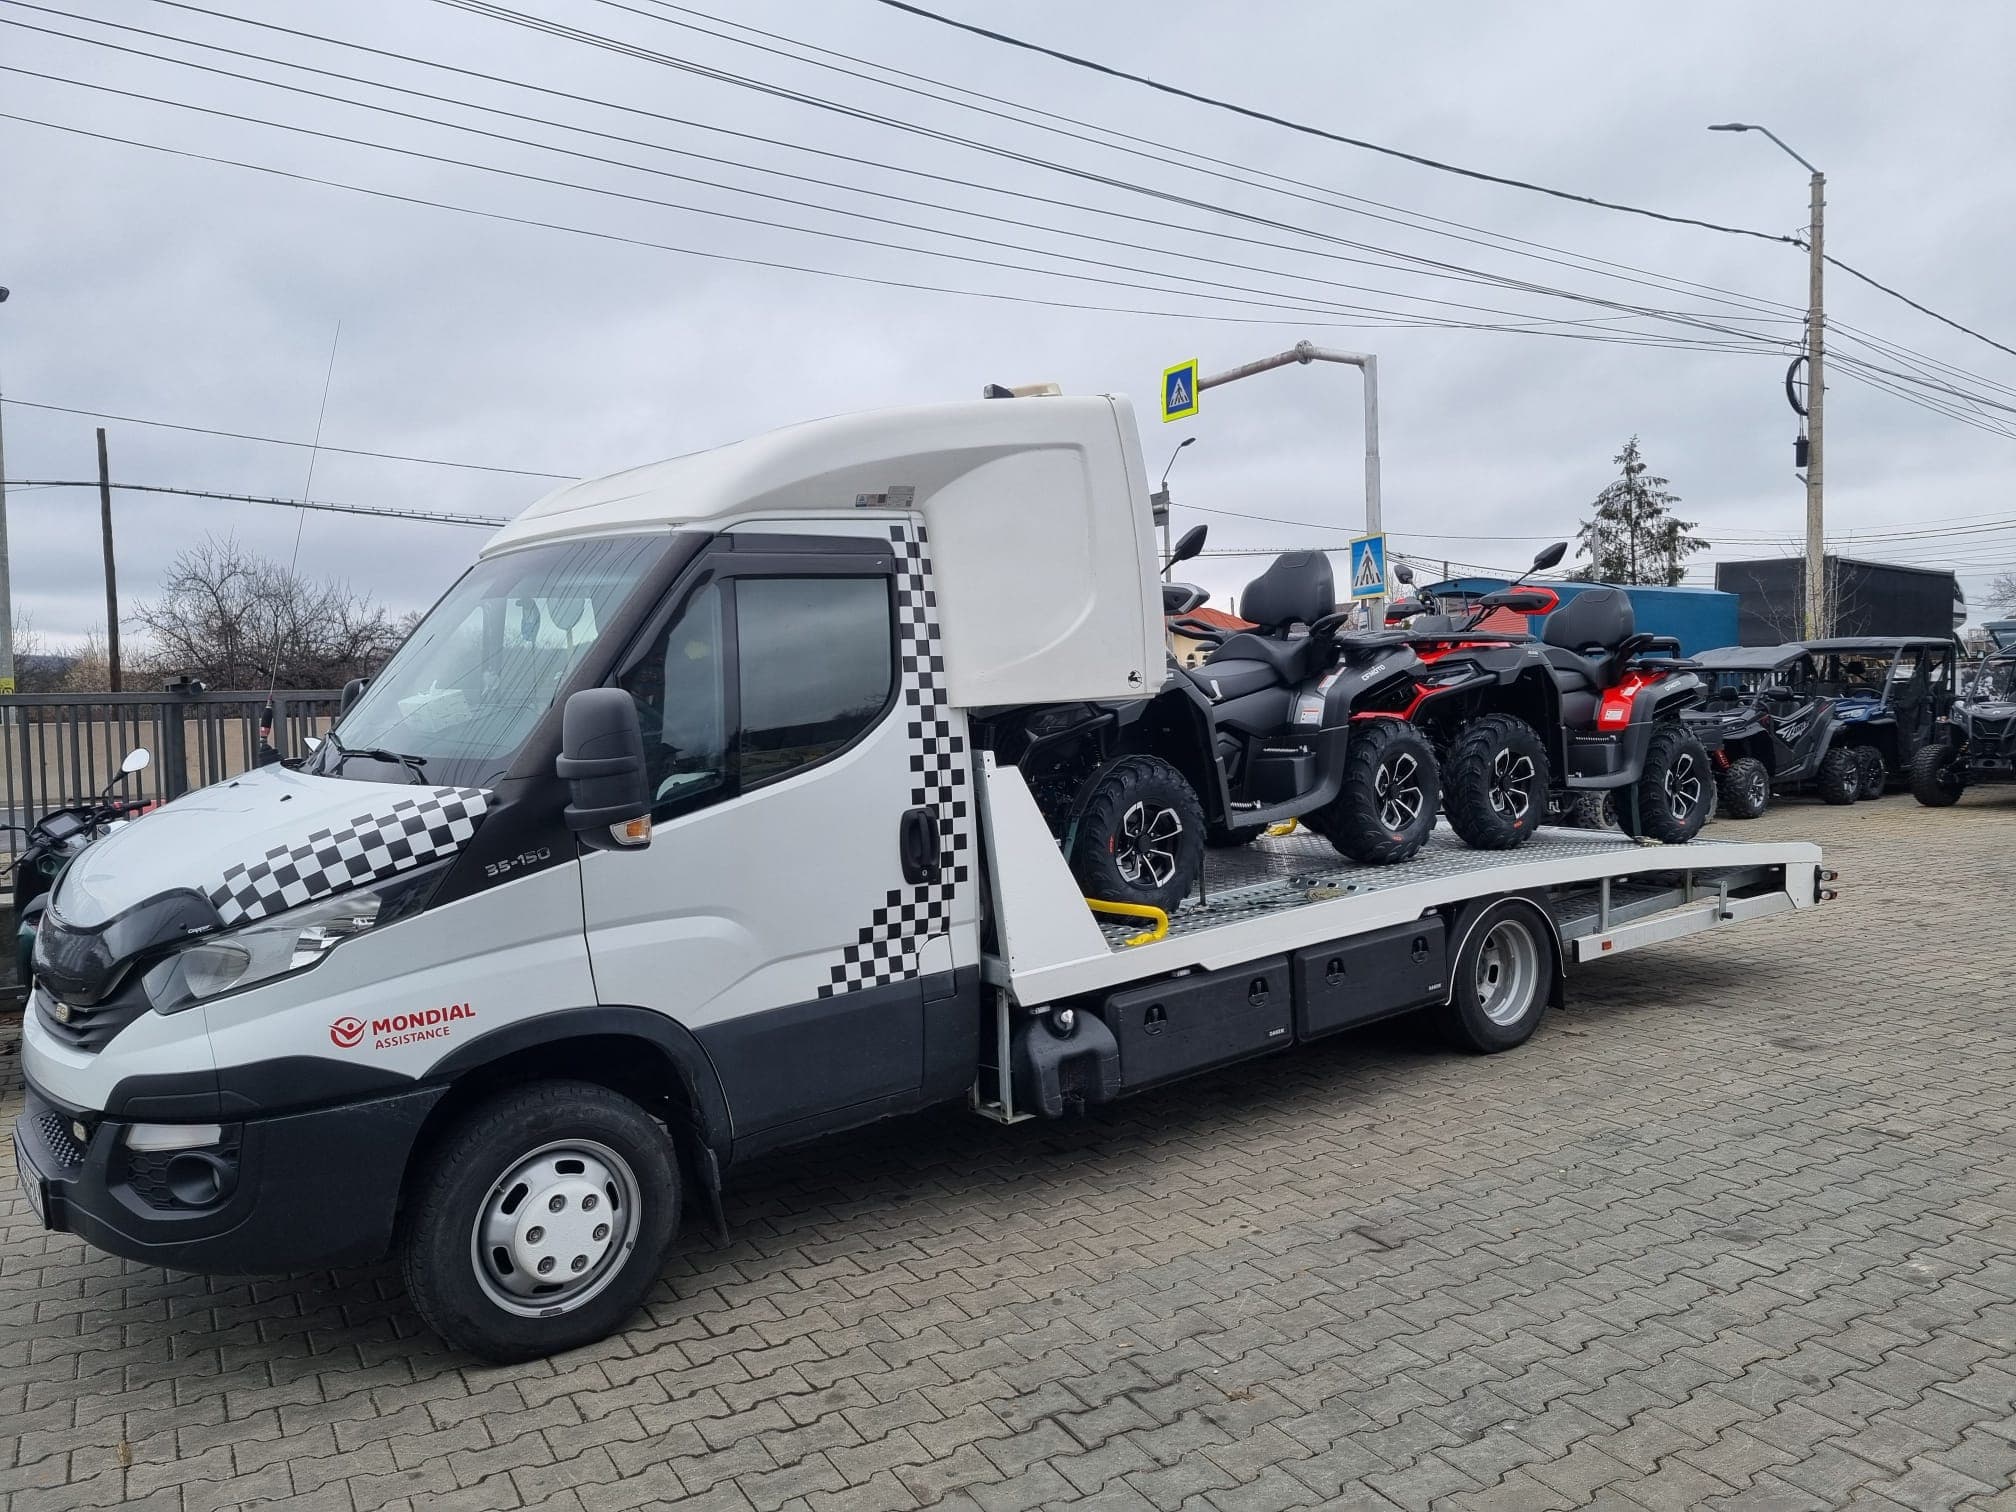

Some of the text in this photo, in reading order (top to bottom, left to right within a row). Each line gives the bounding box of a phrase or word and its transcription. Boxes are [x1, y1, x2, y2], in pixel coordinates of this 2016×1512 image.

[484, 847, 551, 878] 35-150
[371, 1002, 476, 1036] MONDIAL
[375, 1026, 451, 1050] ASSISTANCE
